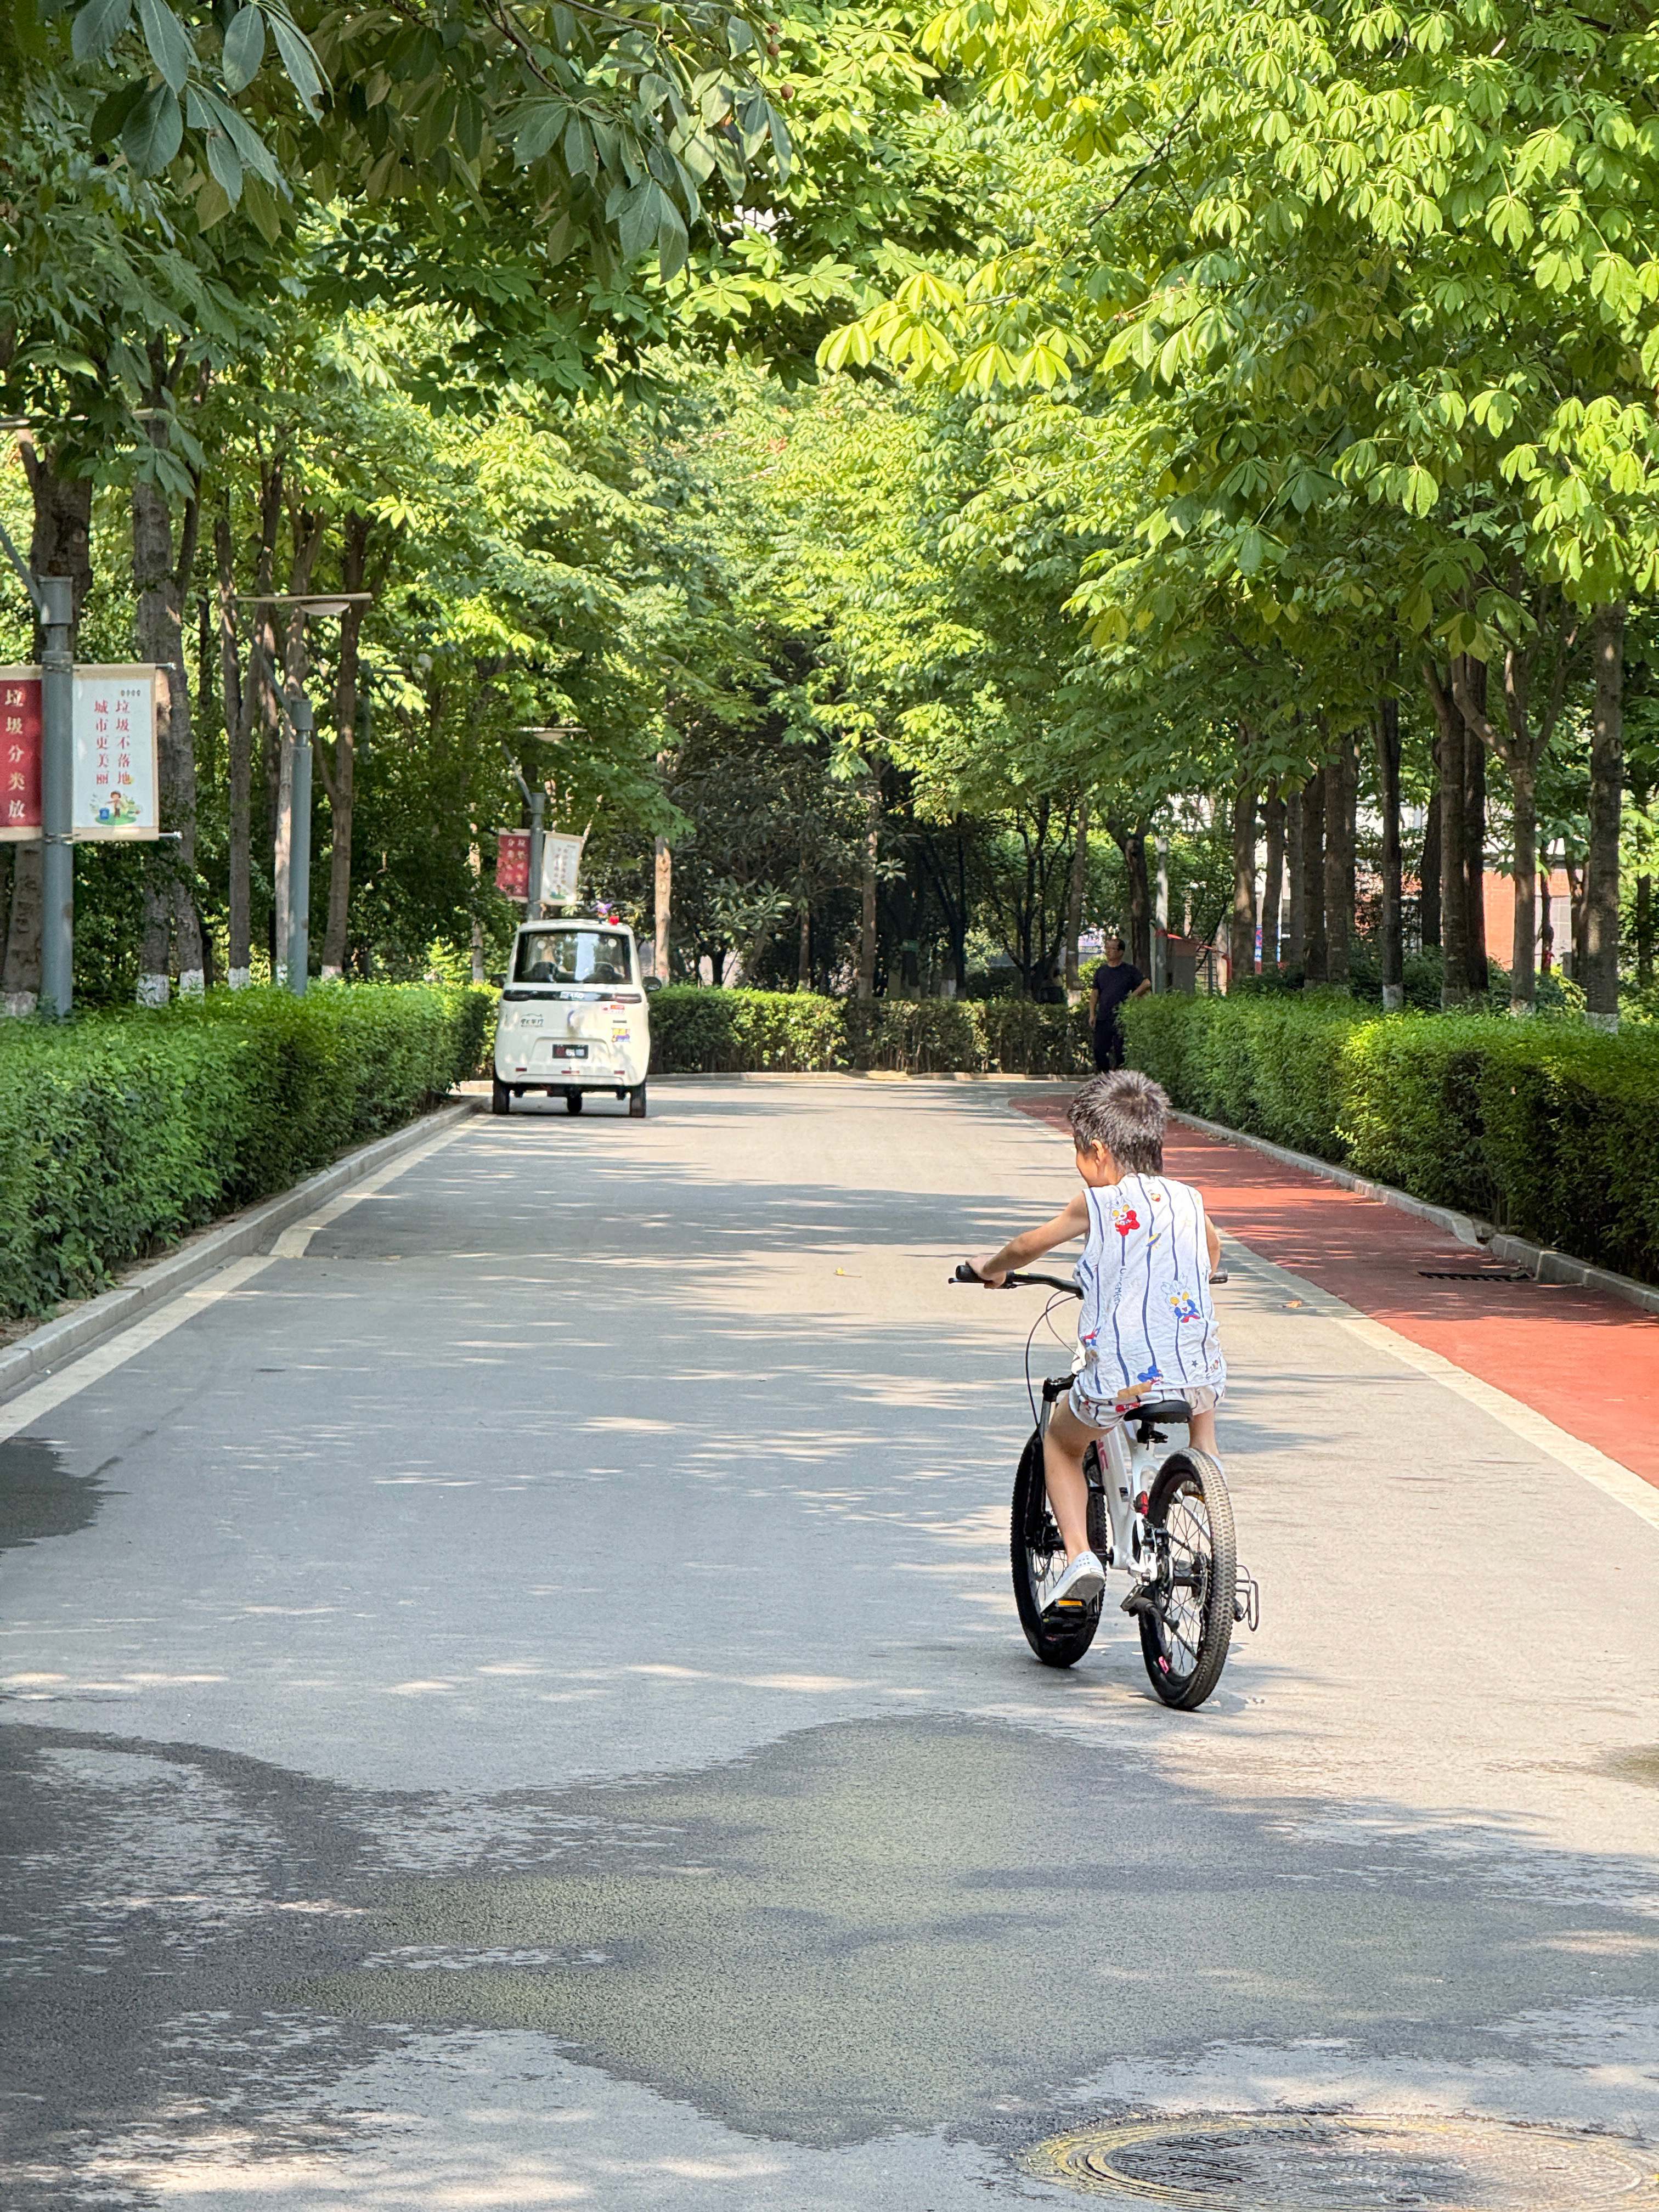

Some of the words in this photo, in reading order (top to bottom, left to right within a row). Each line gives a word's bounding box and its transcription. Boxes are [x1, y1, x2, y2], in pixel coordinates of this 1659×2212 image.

[4, 689, 25, 818] 垃圾分类放
[94, 699, 110, 785] 城市更美丽
[115, 699, 132, 785] 垃圾不落地
